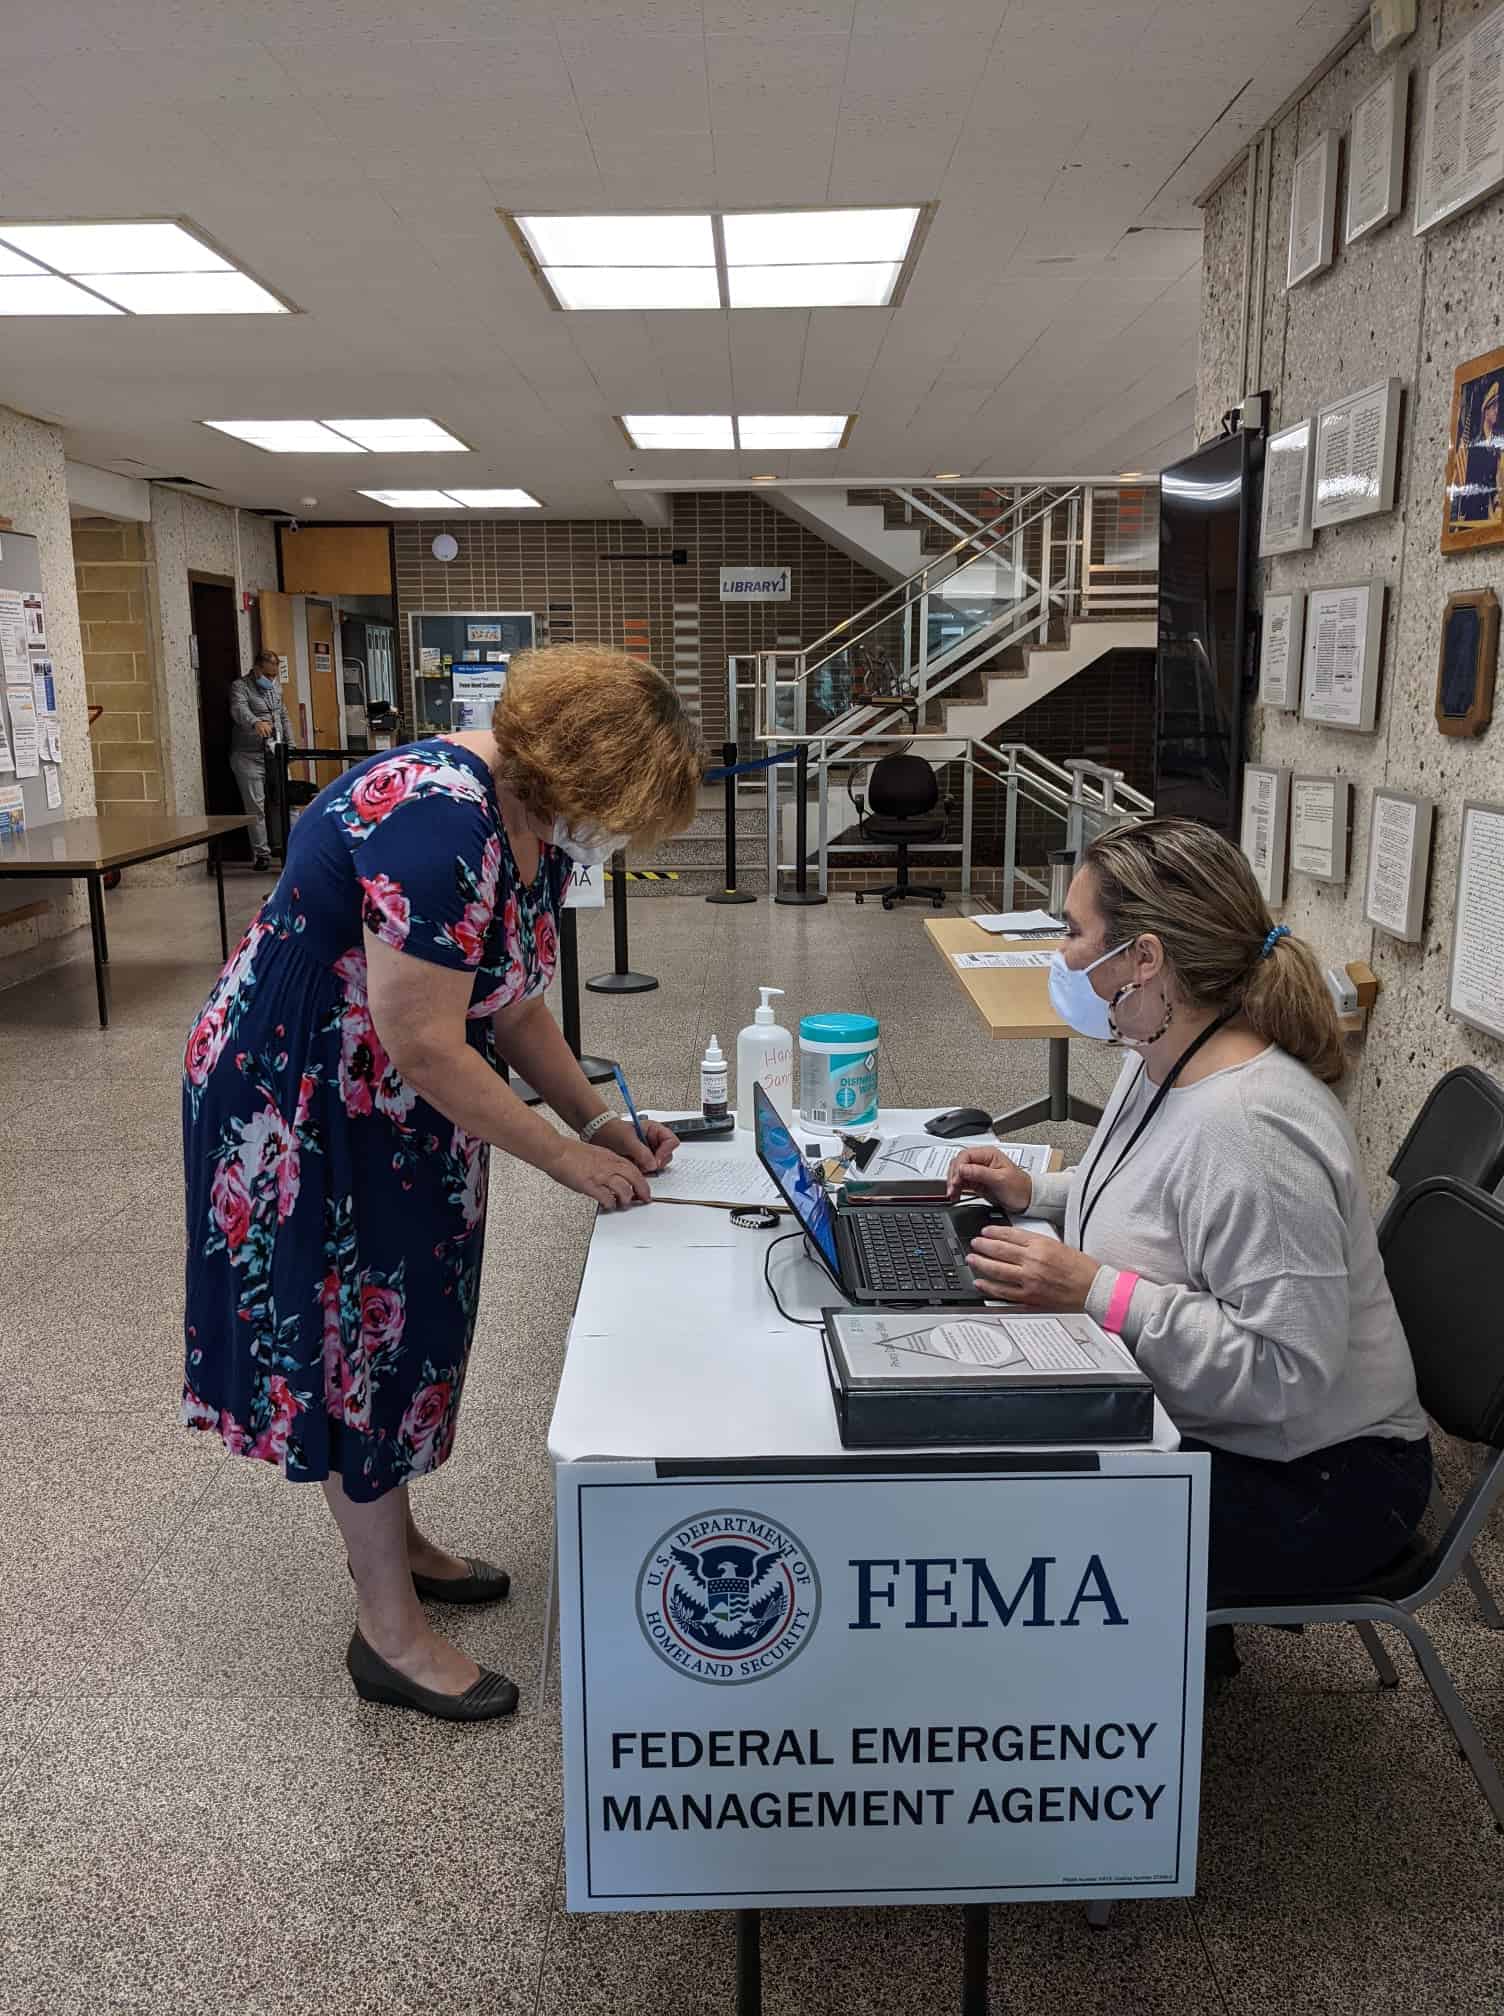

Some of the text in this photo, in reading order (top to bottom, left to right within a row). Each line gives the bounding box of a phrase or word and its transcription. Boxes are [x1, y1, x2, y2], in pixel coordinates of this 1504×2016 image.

[722, 581, 780, 593] LIBRARY
[764, 1047, 792, 1067] Han
[647, 1518, 811, 1586] U.S. DEPARTMENT OF
[848, 1554, 1129, 1629] FEMA
[646, 1608, 810, 1677] HOMELAND SECURITY
[612, 1722, 1158, 1769] FEDERAL EMERGENCY
[603, 1784, 1166, 1832] MANAGEMENT AGENCY
